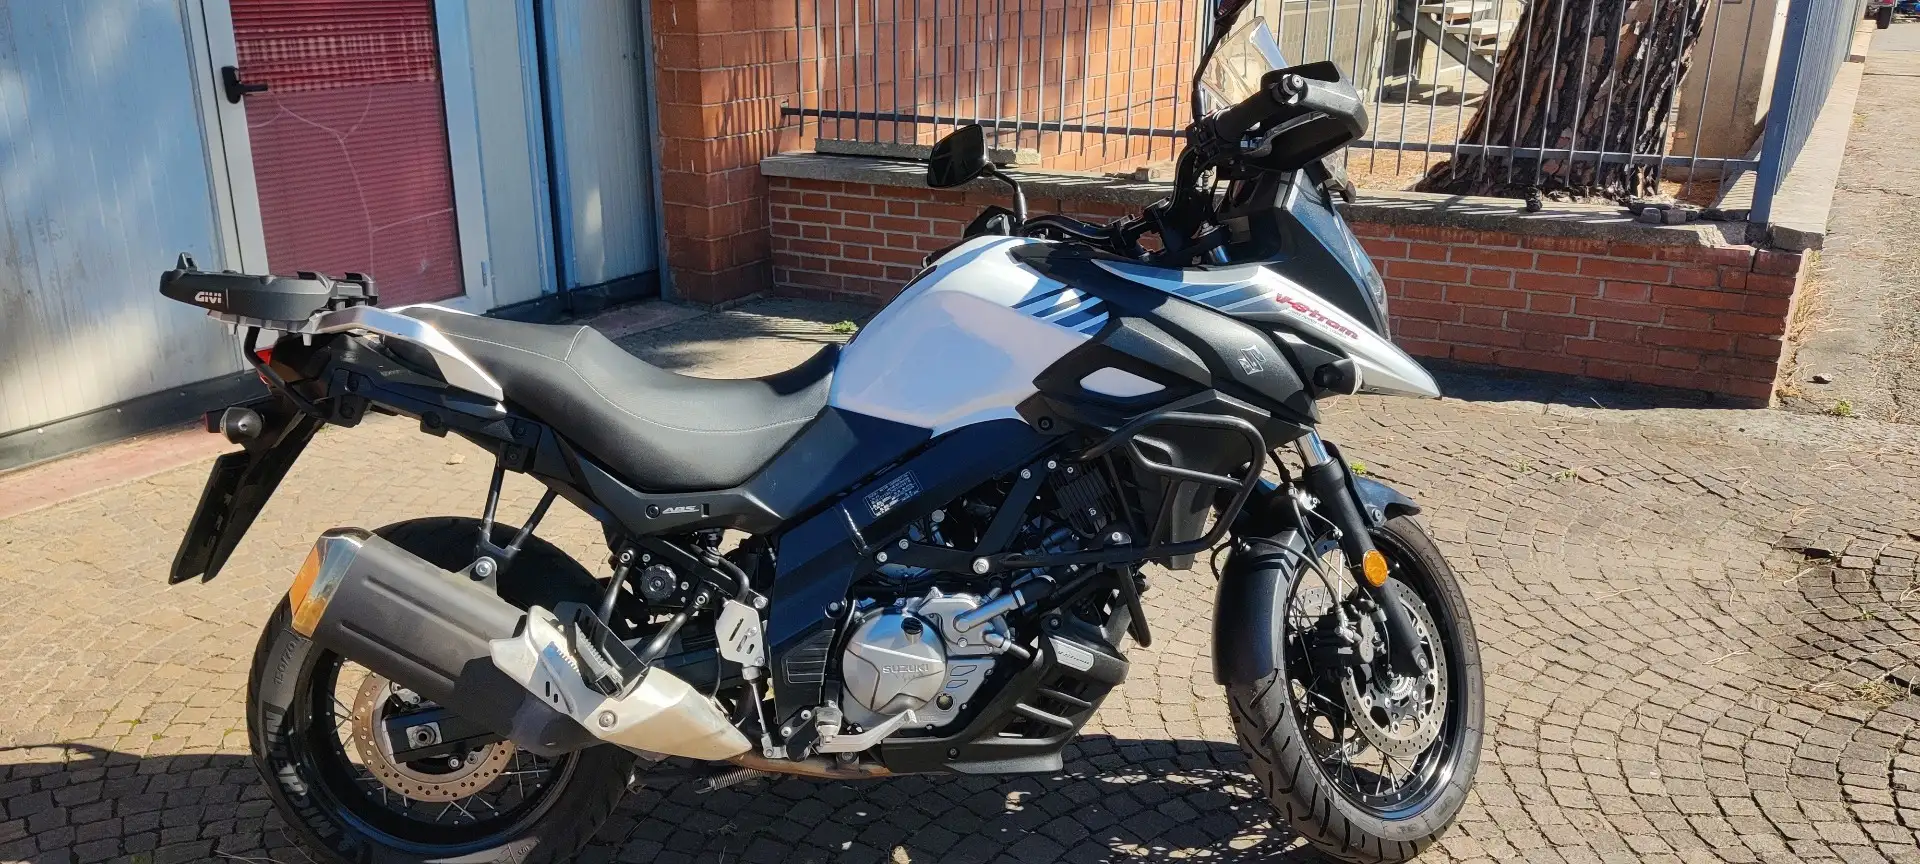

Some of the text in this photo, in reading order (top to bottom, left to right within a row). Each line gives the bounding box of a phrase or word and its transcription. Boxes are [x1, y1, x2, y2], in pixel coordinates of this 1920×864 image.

[194, 290, 222, 304] GIVI
[1275, 292, 1359, 340] V-Strom
[661, 505, 700, 515] ABS
[881, 663, 929, 674] SUZUKI
